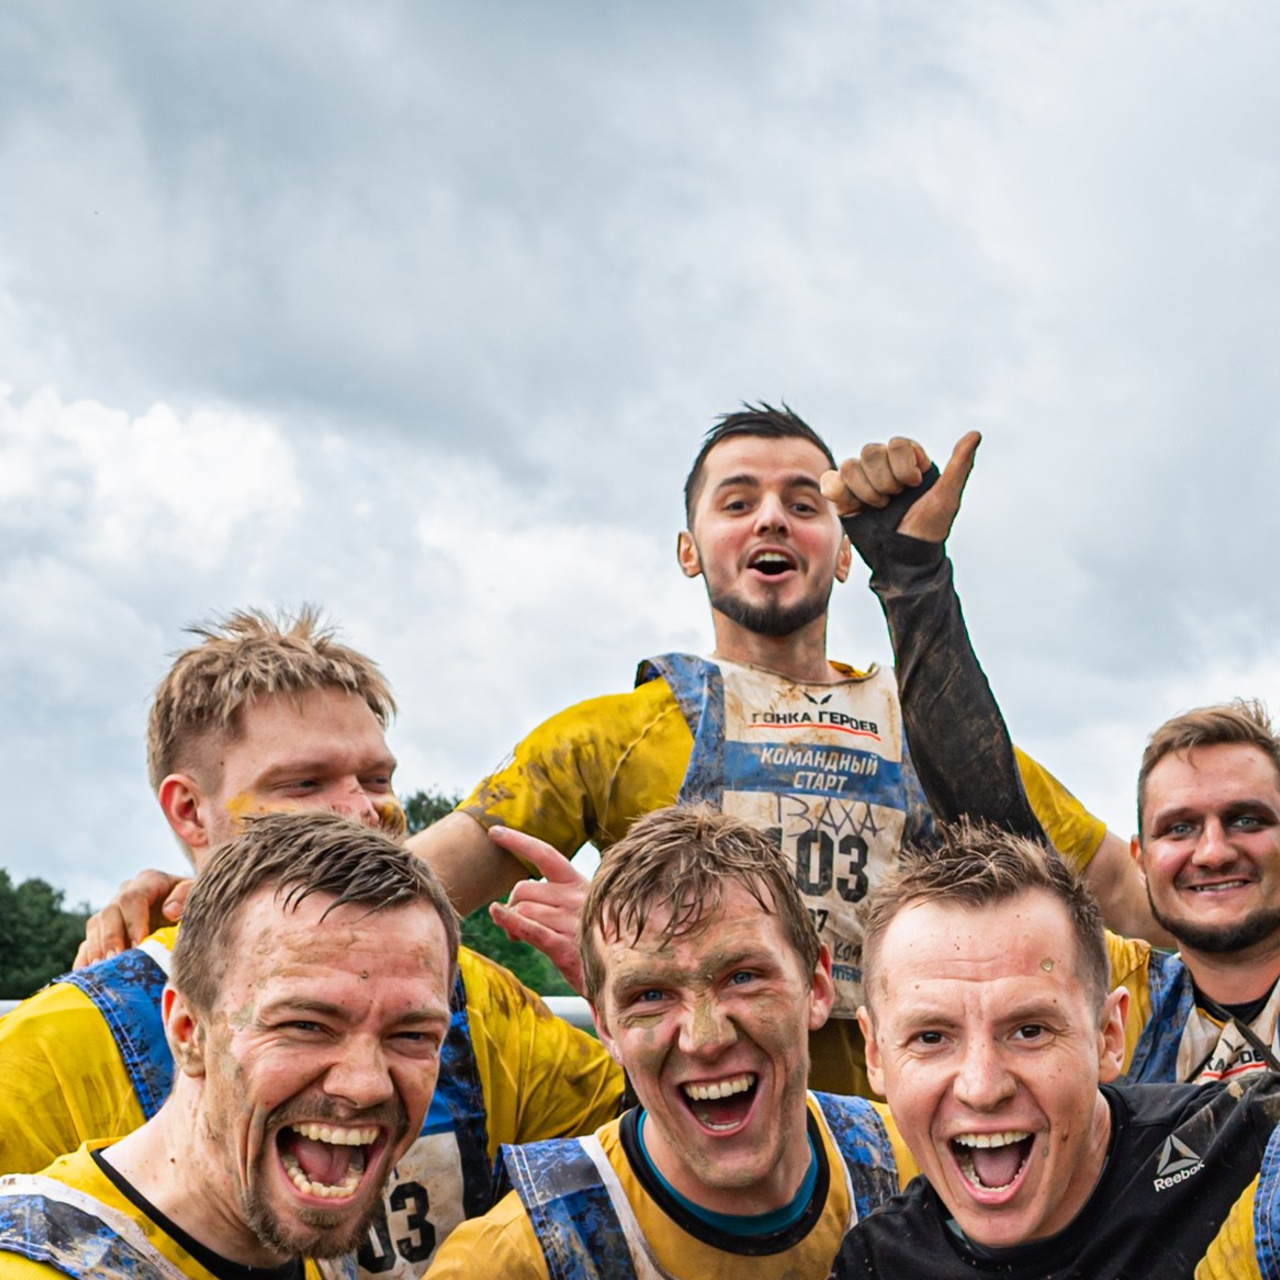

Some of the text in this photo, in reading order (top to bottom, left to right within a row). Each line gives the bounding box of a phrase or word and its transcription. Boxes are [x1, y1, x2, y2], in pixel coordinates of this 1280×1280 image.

[751, 711, 878, 734] ГОНКА ГЕРОЕВ
[760, 747, 878, 776] КОМАНДНЫЙ
[793, 771, 848, 793] СТАРТ
[1153, 1160, 1205, 1192] Reebok
